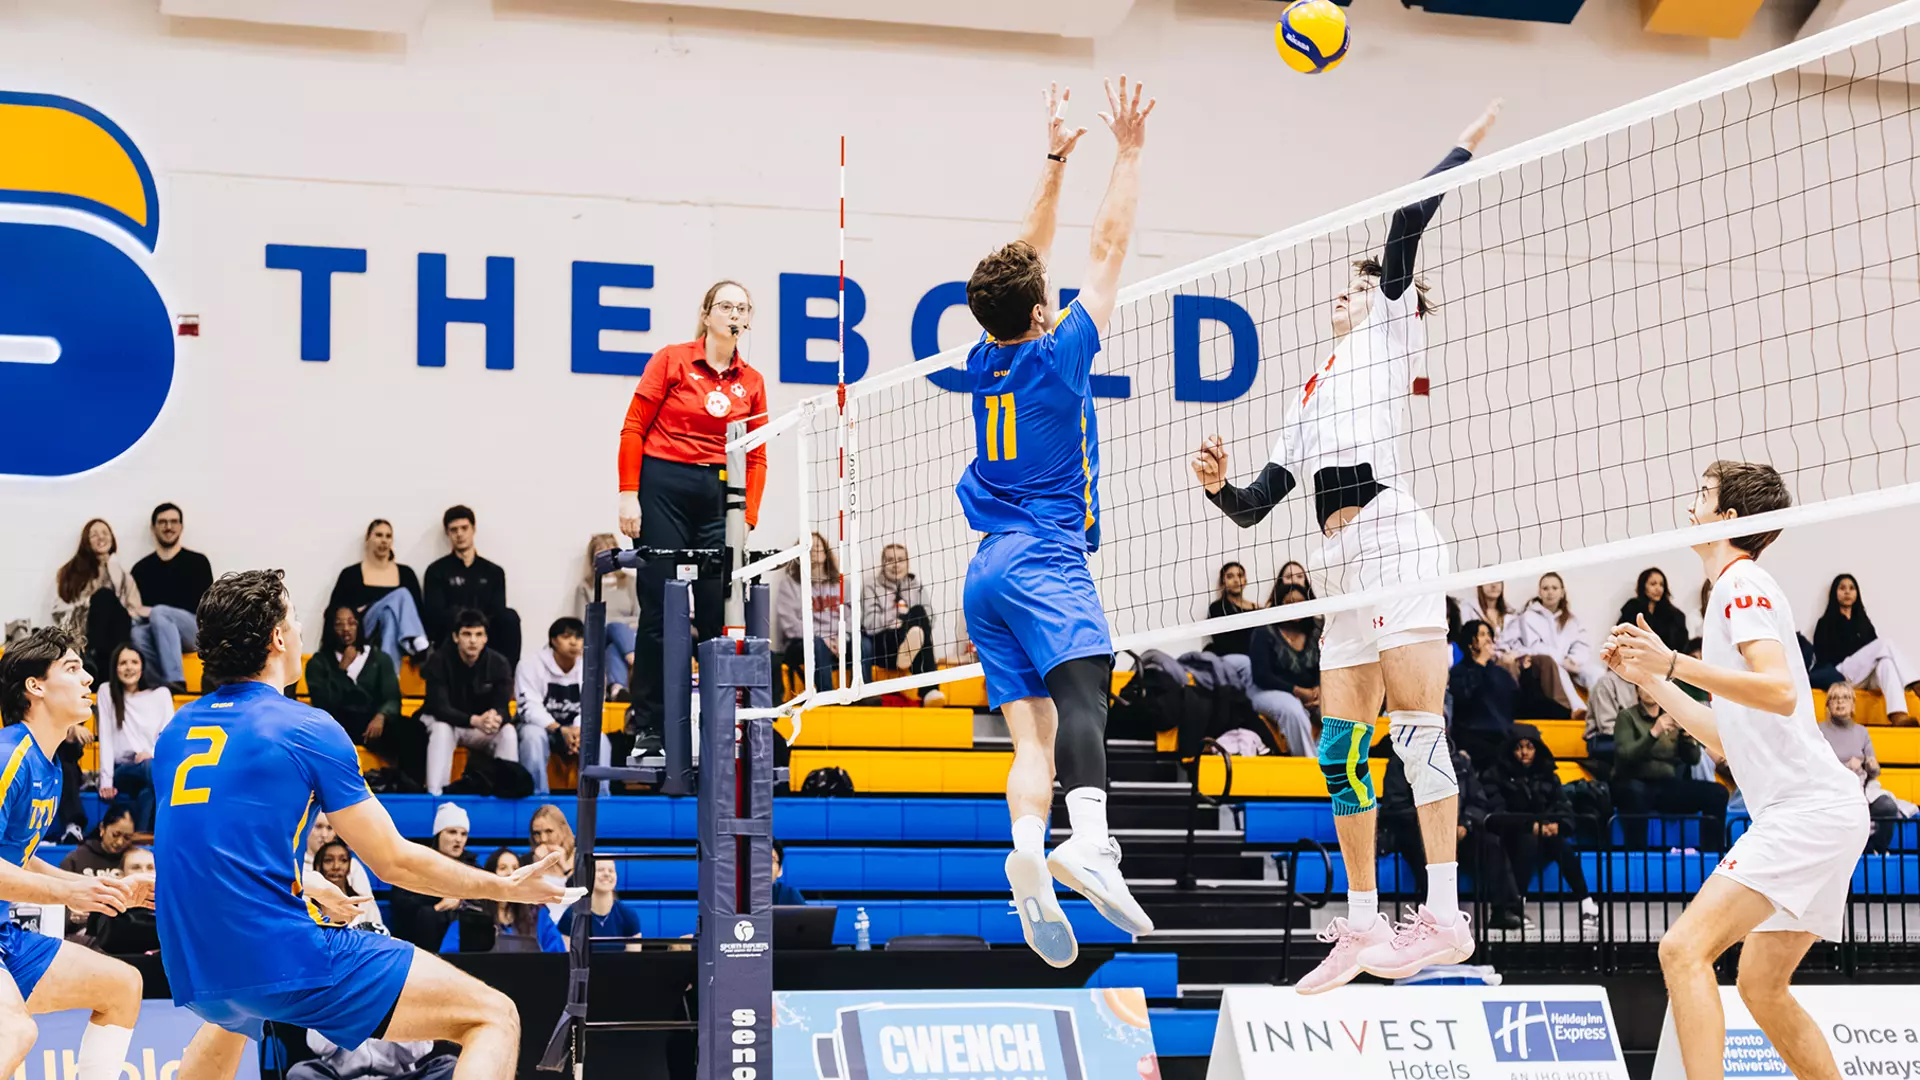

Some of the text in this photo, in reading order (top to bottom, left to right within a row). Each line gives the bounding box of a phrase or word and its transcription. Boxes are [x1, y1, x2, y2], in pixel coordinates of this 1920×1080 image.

[265, 243, 655, 375] THE
[984, 392, 1017, 462] 11
[170, 725, 229, 806] 2
[1551, 1013, 1603, 1027] Holiday Inn
[1247, 1019, 1458, 1054] INNVEST
[1555, 1025, 1607, 1043] Express
[1724, 1034, 1764, 1046] oronto
[1833, 1024, 1918, 1044] Once a
[879, 1023, 1046, 1074] CWENCH
[1389, 1060, 1470, 1080] Hotels
[1723, 1059, 1787, 1074] University
